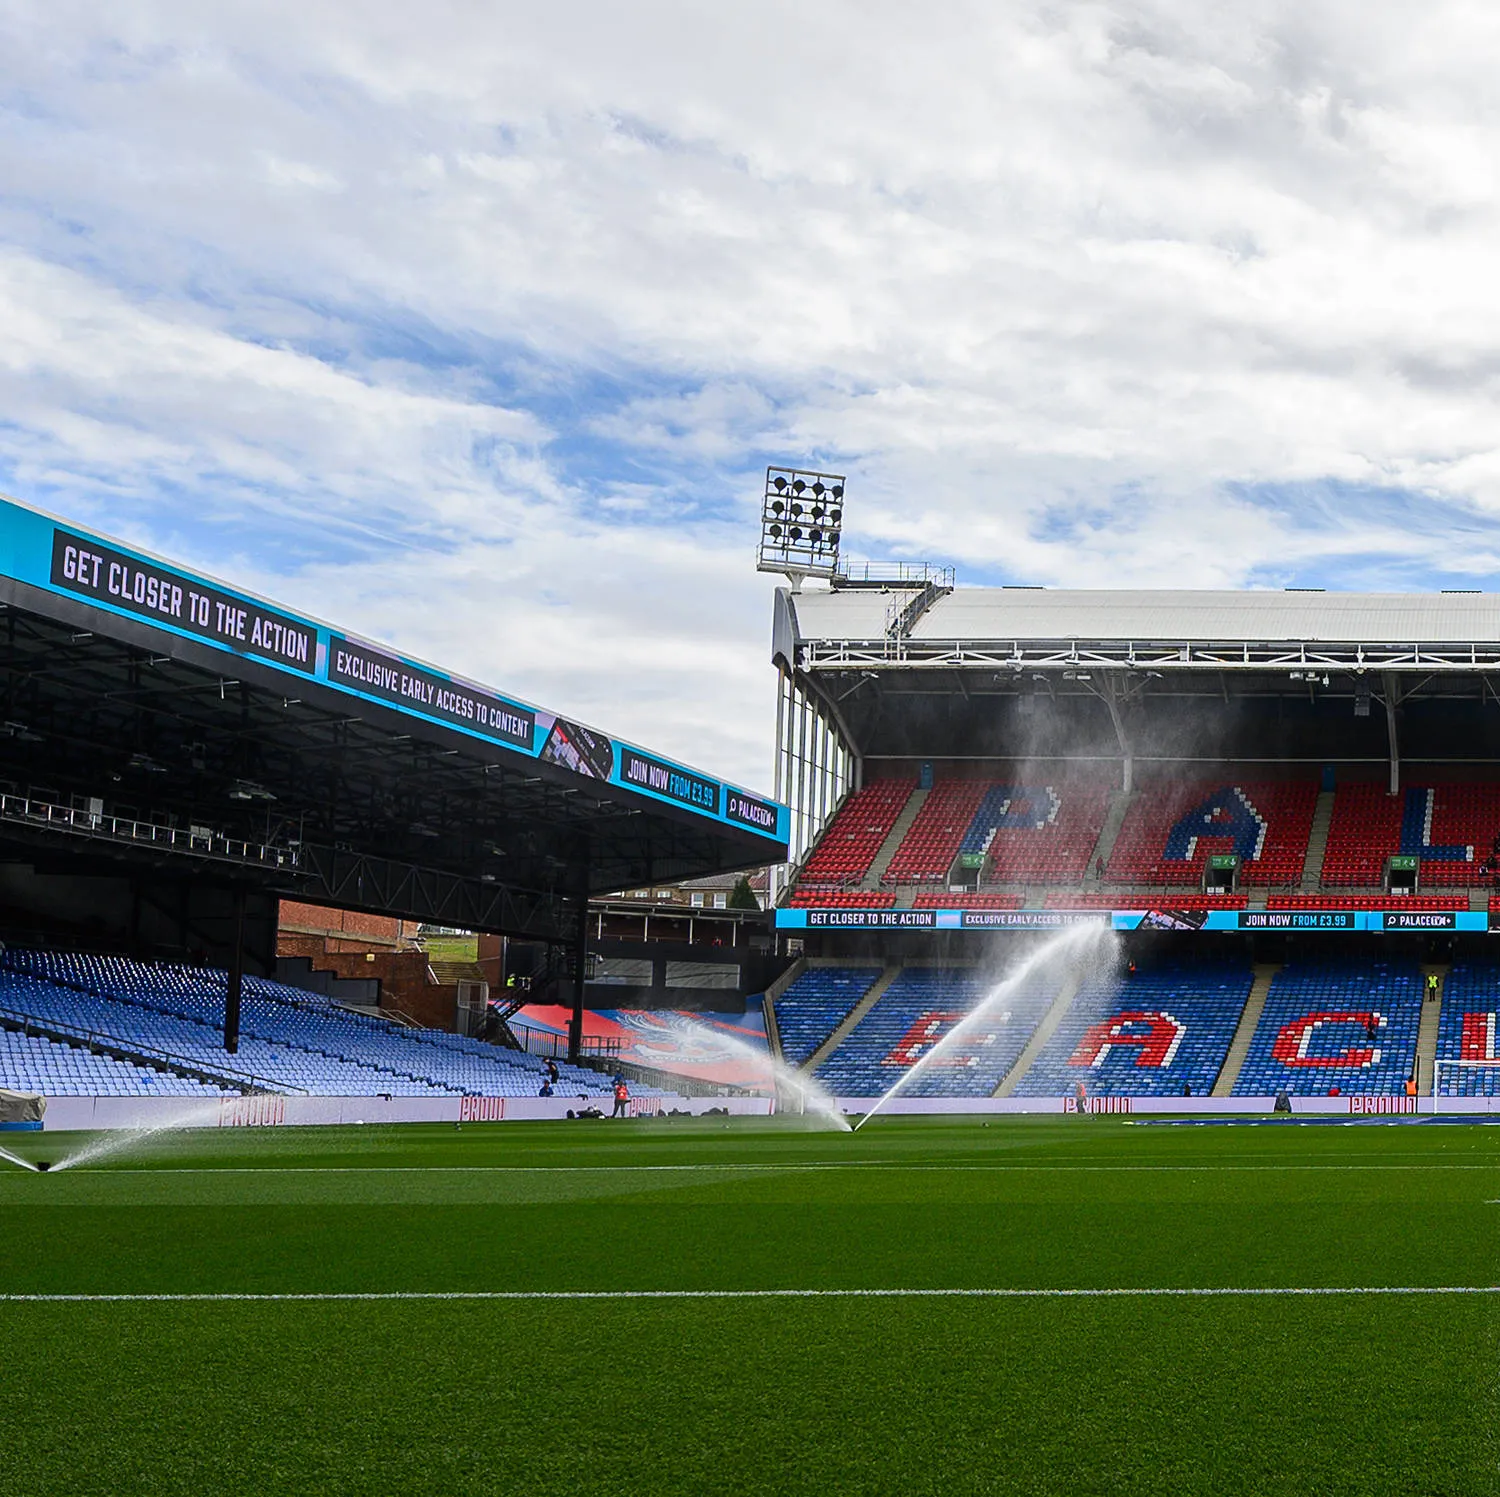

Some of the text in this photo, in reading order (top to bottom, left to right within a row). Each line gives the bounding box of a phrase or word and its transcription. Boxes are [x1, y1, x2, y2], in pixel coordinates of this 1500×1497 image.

[63, 545, 308, 663] GET CLOSER TO THE ACTION
[336, 650, 528, 738] EXCLUSIVE EARLY ACCESS TO CONTENT
[628, 758, 714, 807] JOIN NOW FROM £3.99
[810, 913, 932, 924] GET CLOSER TO THE ACTION
[966, 914, 1005, 924] EXCLUSIVE
[1008, 914, 1031, 924] EARLY
[1033, 914, 1060, 924] ACCESS
[1063, 914, 1072, 924] TO
[1246, 915, 1346, 926] JOIN NOW FROM £3.99
[460, 1096, 506, 1120] PROUD
